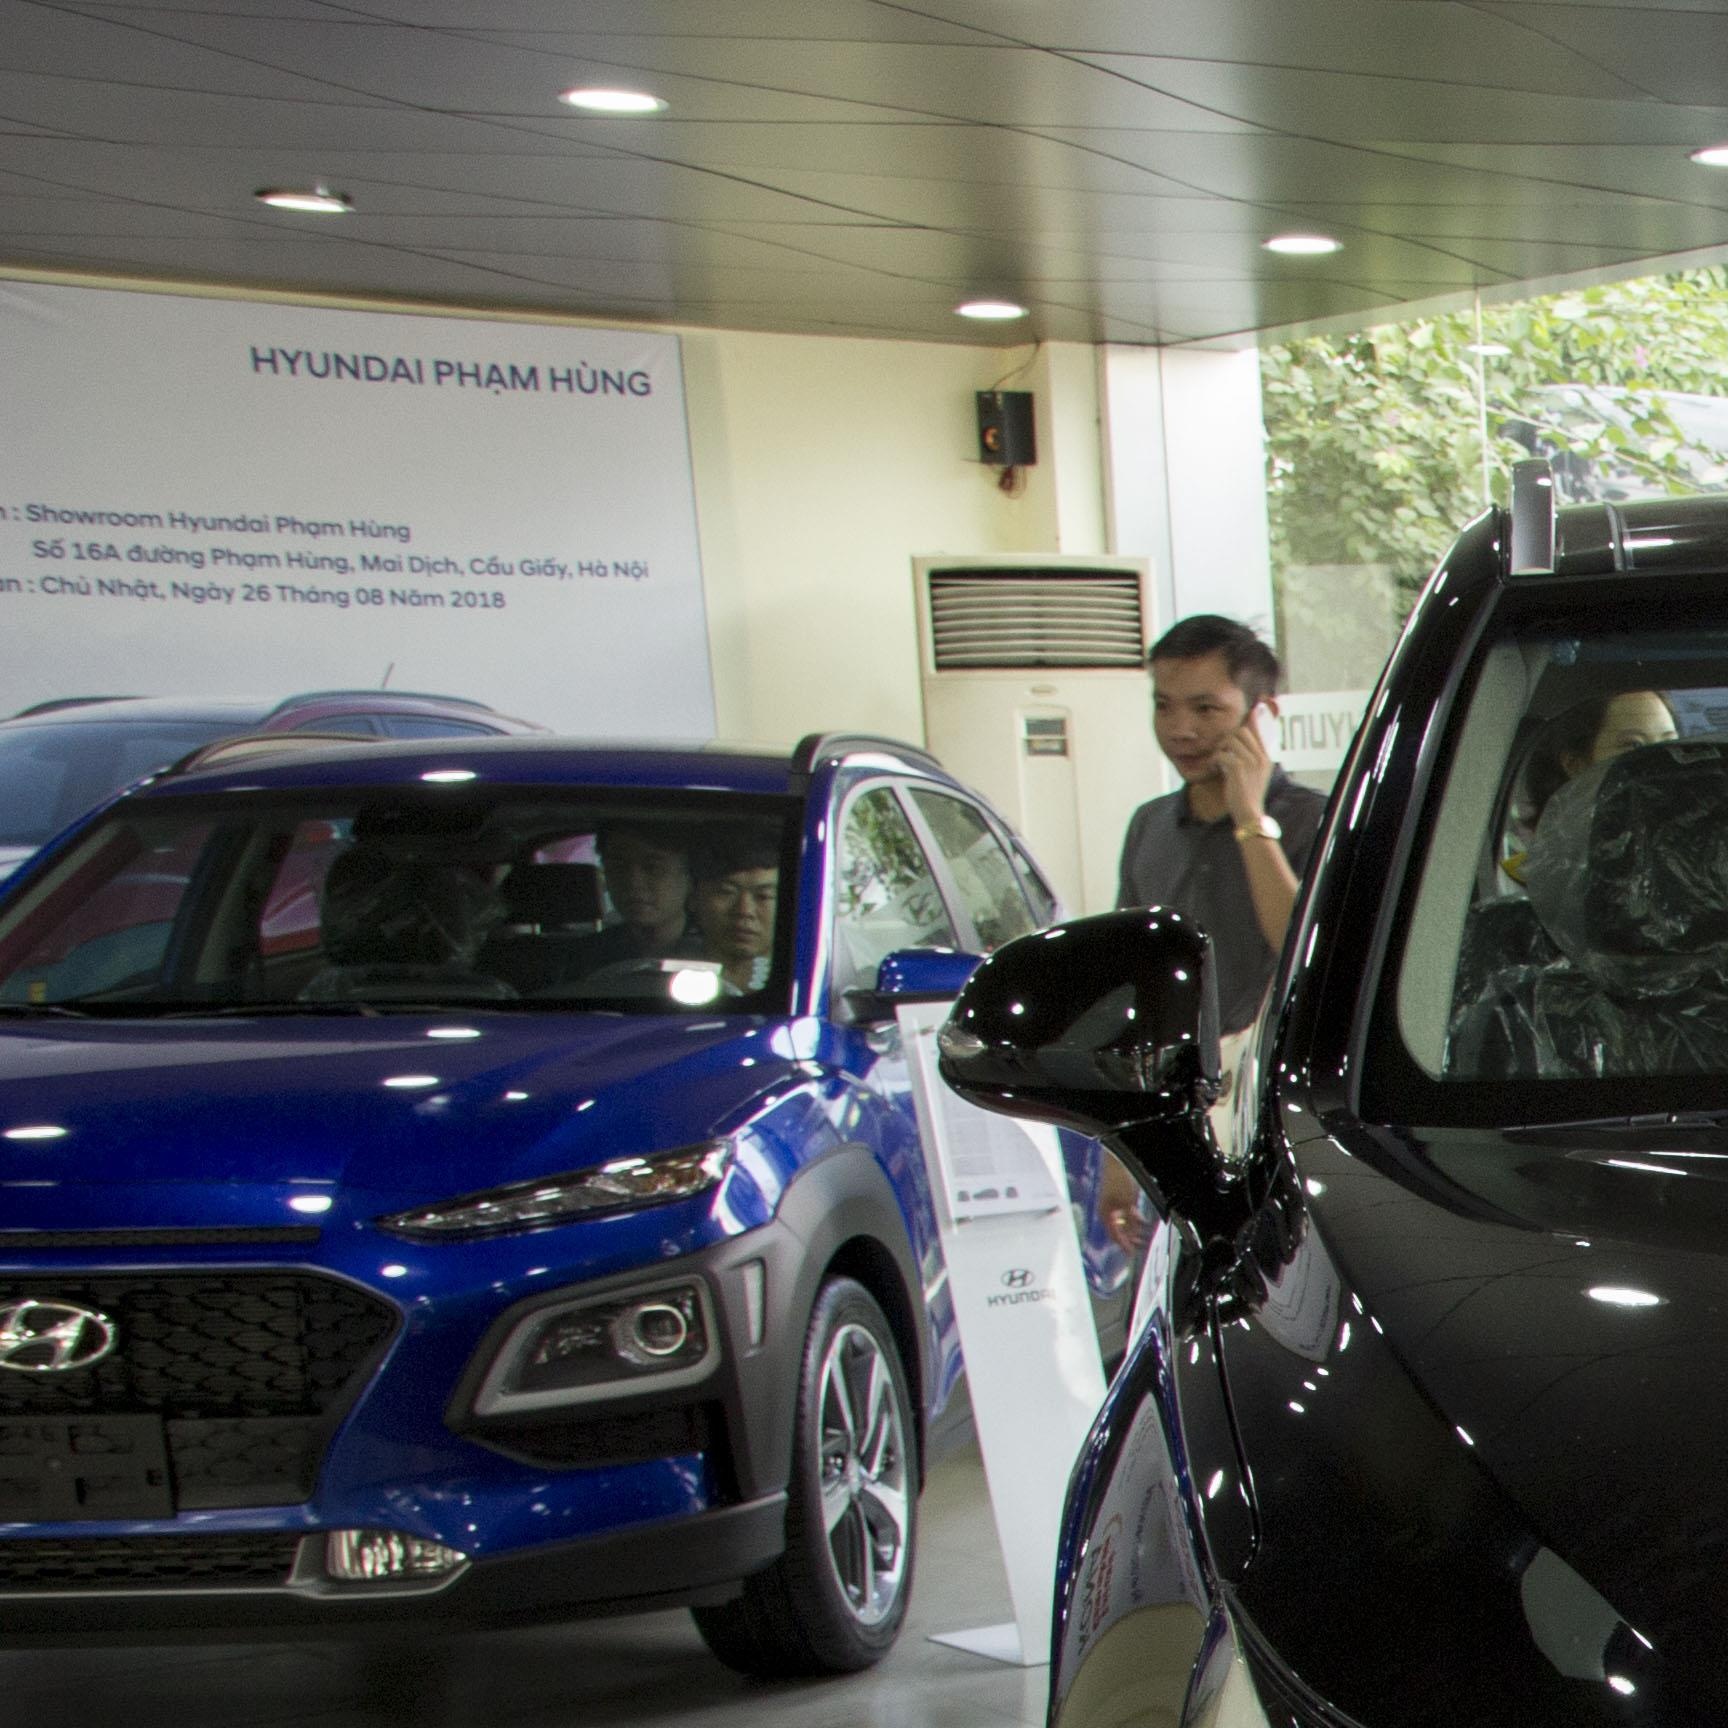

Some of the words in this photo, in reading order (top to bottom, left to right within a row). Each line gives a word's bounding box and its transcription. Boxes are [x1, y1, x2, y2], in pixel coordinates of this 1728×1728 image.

[250, 346, 424, 384] HYUNDAI
[434, 359, 540, 396] PHẠM
[551, 361, 653, 397] HÙNG
[26, 503, 163, 528] Showroom
[168, 511, 271, 534] Hyundai
[275, 515, 345, 539] Phạm
[350, 519, 411, 543] Hùng
[32, 537, 66, 560] Số
[72, 542, 122, 562] 16A
[211, 548, 281, 571] Phạm
[286, 551, 355, 574] Hùng,
[360, 553, 403, 573] Mai
[578, 560, 609, 578] Hà
[613, 560, 649, 581] Nội
[172, 581, 235, 604] Ngày
[241, 583, 271, 602] 26
[275, 585, 350, 609] Tháng
[355, 587, 384, 606] 08
[389, 589, 445, 607] Năm
[450, 590, 506, 609] 2018
